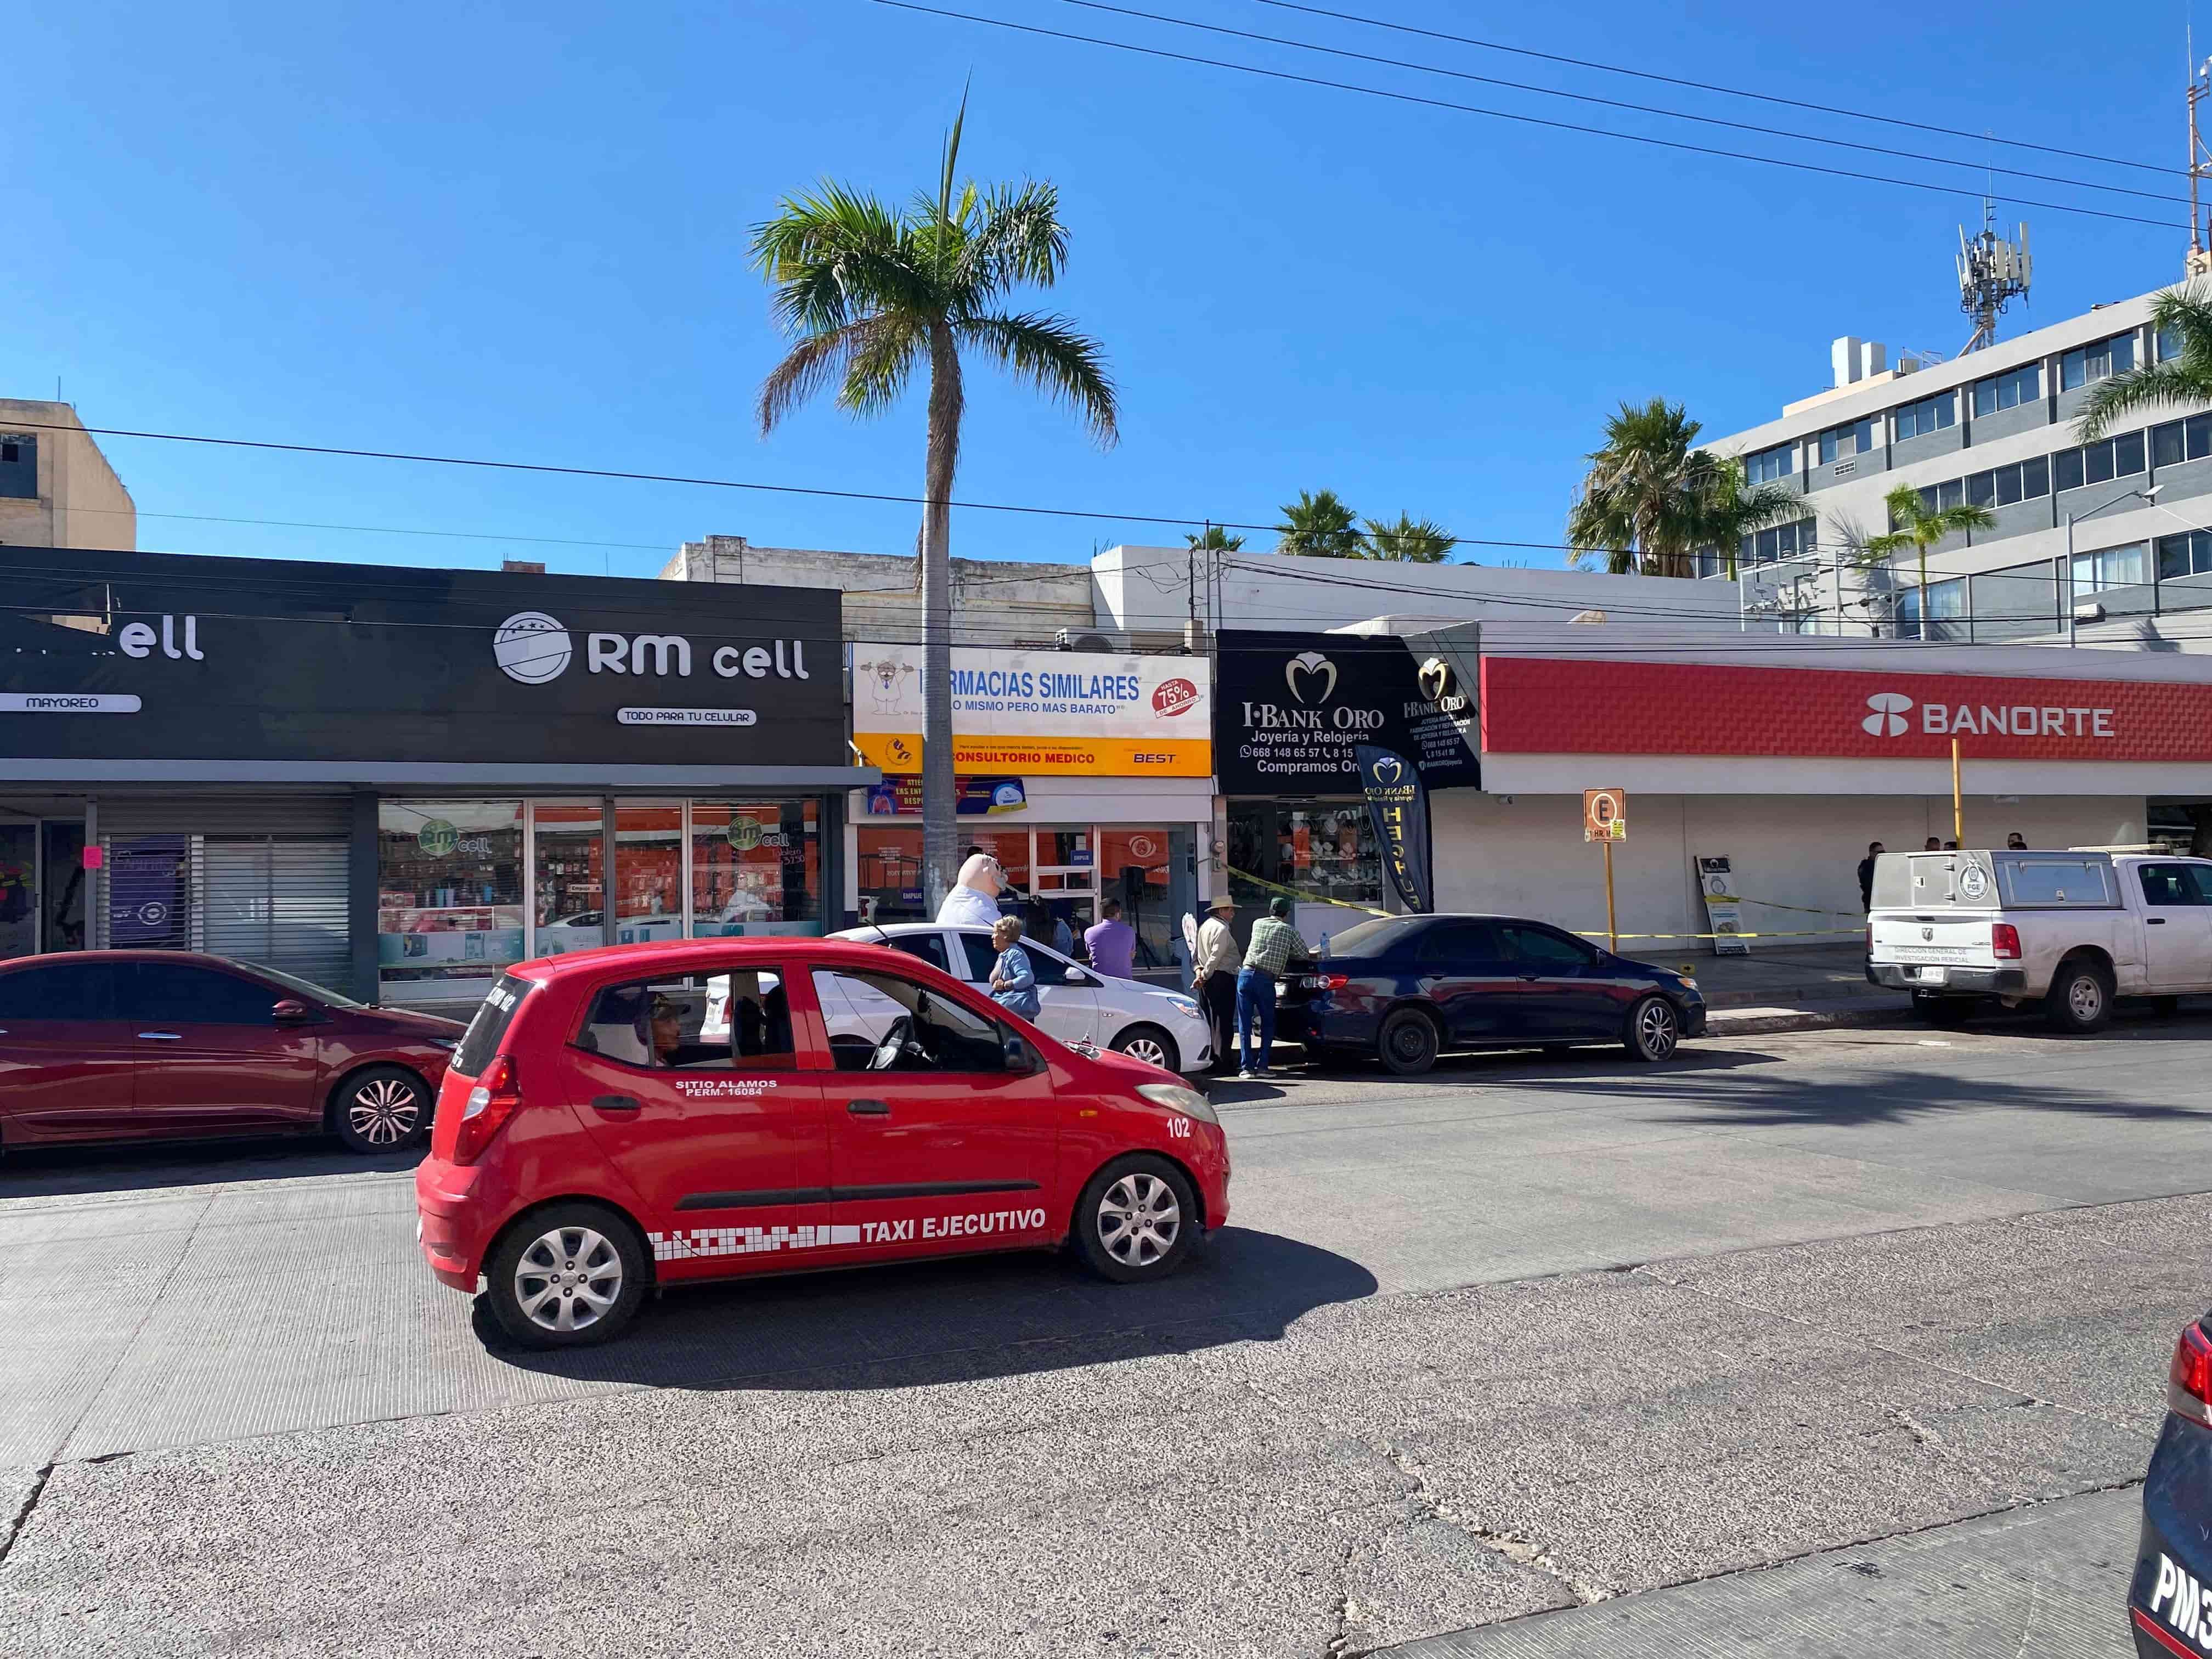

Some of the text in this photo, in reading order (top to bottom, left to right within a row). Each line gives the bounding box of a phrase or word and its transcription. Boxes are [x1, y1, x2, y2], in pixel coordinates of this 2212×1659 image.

[712, 639, 810, 680] cell
[919, 669, 1139, 701] RMACIAS SIMILARES
[1161, 680, 1180, 691] HASTA
[1158, 683, 1189, 707] 75%
[26, 697, 99, 708] MAYOREO
[965, 701, 1005, 712] MISMO
[1007, 702, 1039, 713] PERO
[1042, 703, 1067, 714] MAS
[1171, 697, 1197, 710] AHORRO
[1441, 696, 1464, 712] ORO
[624, 712, 750, 723] TODO PARA TU CELULAR
[1333, 707, 1385, 729] ORO
[1922, 703, 2115, 738] BANORTE
[1251, 731, 1369, 745] Joyería y Relojería
[1045, 753, 1095, 764] MEDICO
[1133, 753, 1177, 764] BEST
[1253, 747, 1353, 758] 668 148 65 57 8 15
[1257, 760, 1338, 776] Compramos
[1599, 799, 1610, 821] E
[456, 837, 489, 853] cell
[762, 833, 789, 847] cell
[675, 1080, 778, 1090] SITIO ALAMOS
[686, 1088, 763, 1097] PERM. 16084
[1166, 1118, 1190, 1138] 102
[862, 1207, 1047, 1244] TAXI EJECUTIVO
